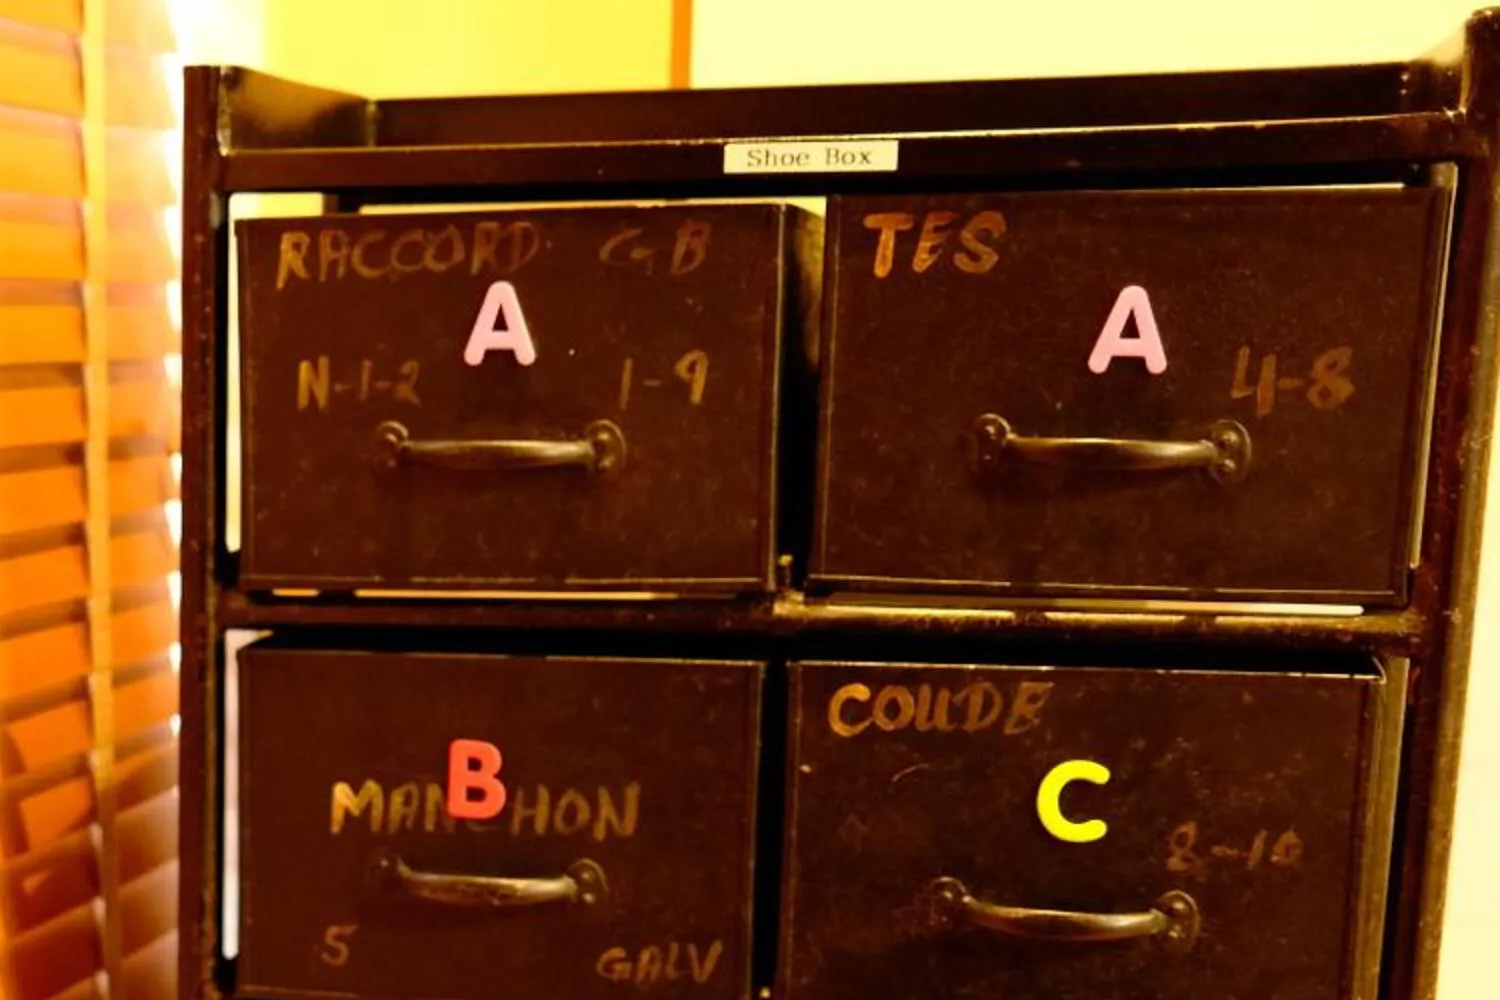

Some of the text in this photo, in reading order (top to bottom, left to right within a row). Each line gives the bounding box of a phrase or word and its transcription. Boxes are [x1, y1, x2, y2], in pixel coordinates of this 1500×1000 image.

[746, 146, 873, 168] Shoe Box
[276, 220, 542, 290] RACCORD
[864, 210, 1007, 279] TES
[464, 280, 536, 366] A
[1088, 285, 1168, 375] A
[1229, 345, 1357, 417] 4-8
[827, 680, 1056, 738] COUDE
[330, 779, 641, 841] MANHON
[446, 738, 507, 820] B
[1036, 758, 1112, 843] C
[320, 923, 358, 968] 5
[596, 939, 724, 985] GALV
